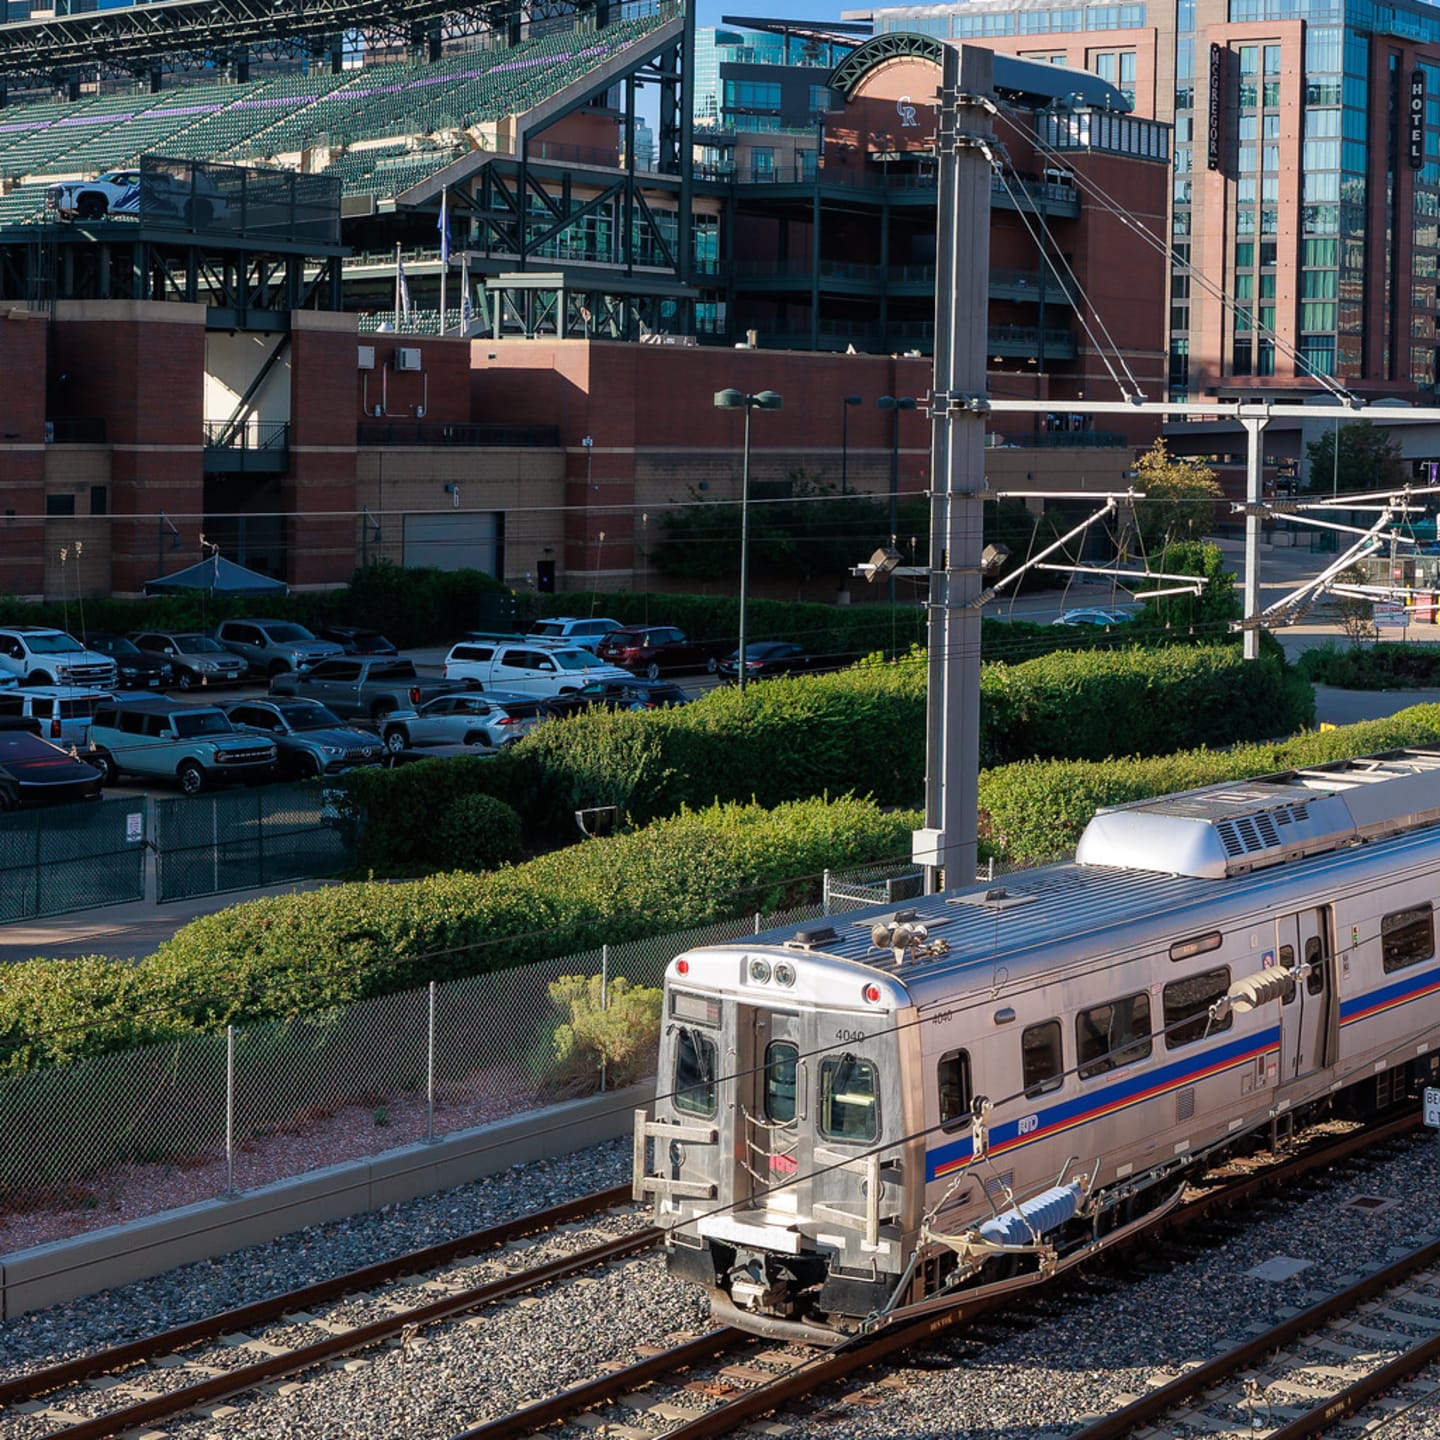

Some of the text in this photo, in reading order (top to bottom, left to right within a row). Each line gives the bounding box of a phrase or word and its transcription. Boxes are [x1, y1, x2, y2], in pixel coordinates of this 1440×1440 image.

[1210, 51, 1219, 154] MCGREGOR
[1412, 83, 1422, 157] HOTEL
[835, 1029, 865, 1042] 4040
[1018, 1114, 1039, 1135] RTD
